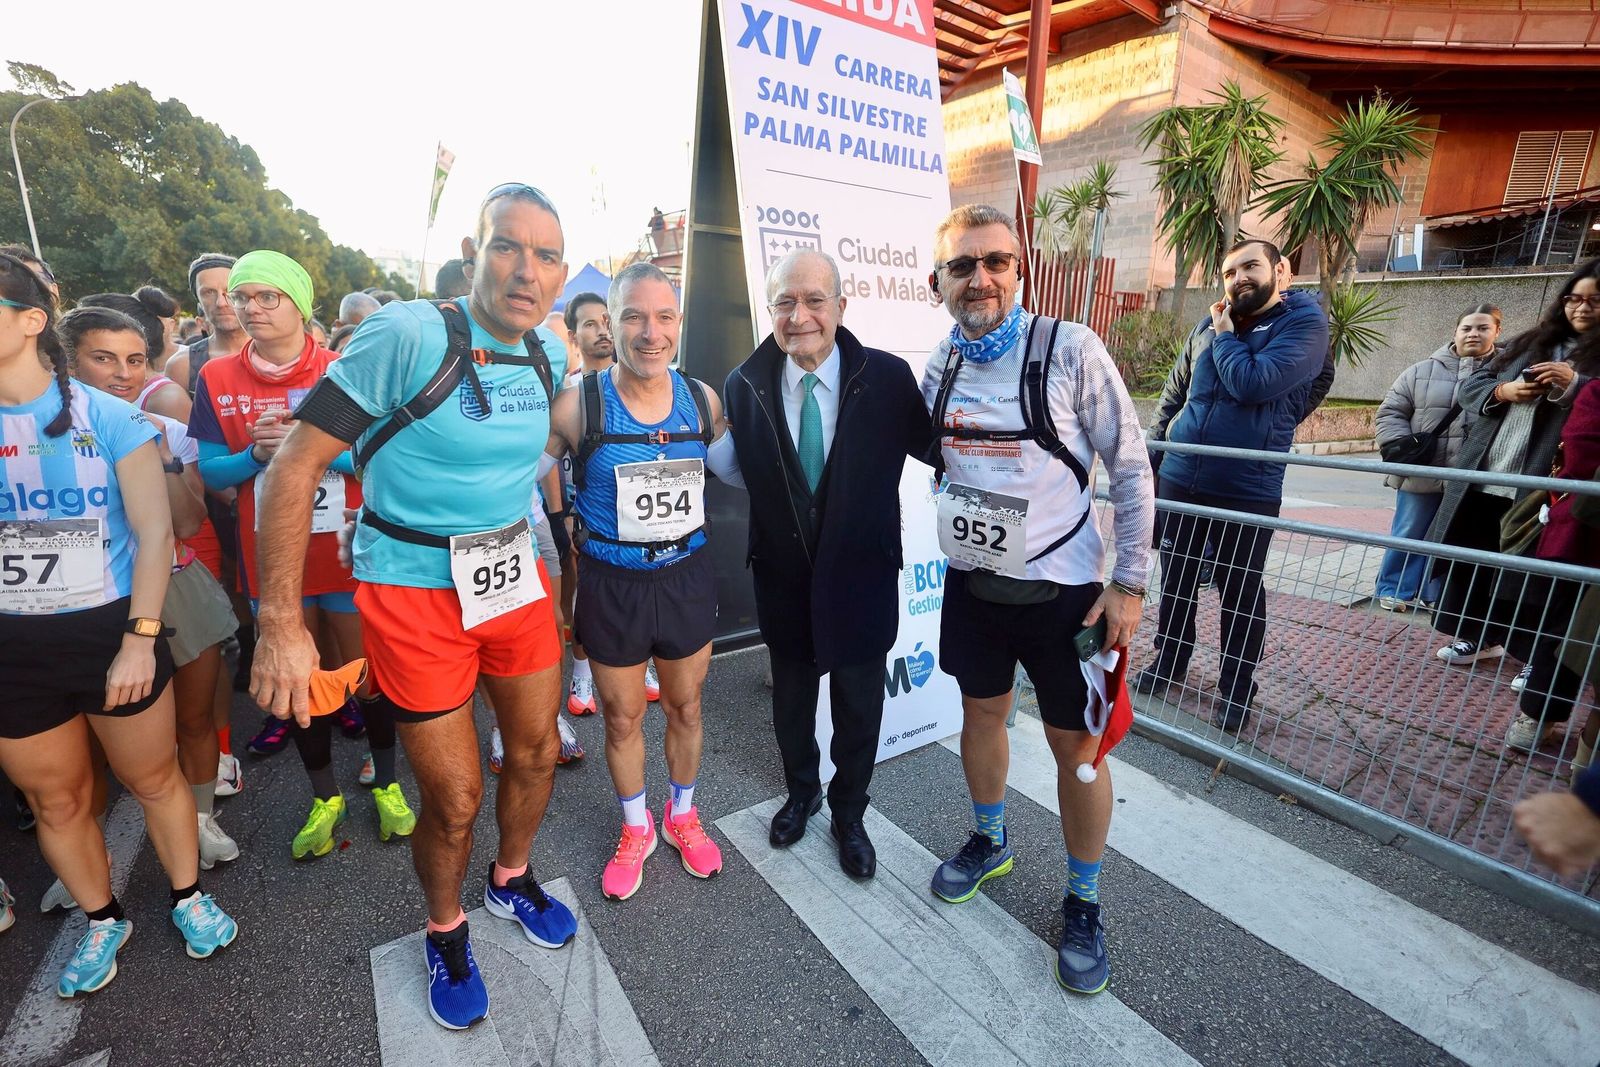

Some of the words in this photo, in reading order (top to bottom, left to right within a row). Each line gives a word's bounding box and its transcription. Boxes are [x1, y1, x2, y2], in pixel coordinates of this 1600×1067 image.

[737, 3, 822, 67] XIV
[834, 54, 933, 100] CARRERA
[757, 76, 809, 110] SAN
[817, 92, 927, 138] SILVESTRE
[744, 111, 832, 153] PALMA
[840, 133, 943, 175] PALMILLA
[837, 237, 918, 269] Ciudad
[841, 272, 870, 298] de
[876, 274, 941, 309] Málag
[498, 384, 537, 398] Ciudad
[500, 401, 515, 413] de
[997, 395, 1020, 403] CaixaB
[958, 448, 971, 456] REAL
[971, 449, 984, 457] CLUB
[0, 480, 108, 516] álaga
[635, 490, 692, 521] 954
[952, 515, 1008, 553] 952
[3, 553, 60, 586] 57
[473, 553, 522, 597] 953
[904, 563, 915, 596] GRUPO
[908, 594, 943, 617] Gestio
[901, 721, 938, 740] deporinter
